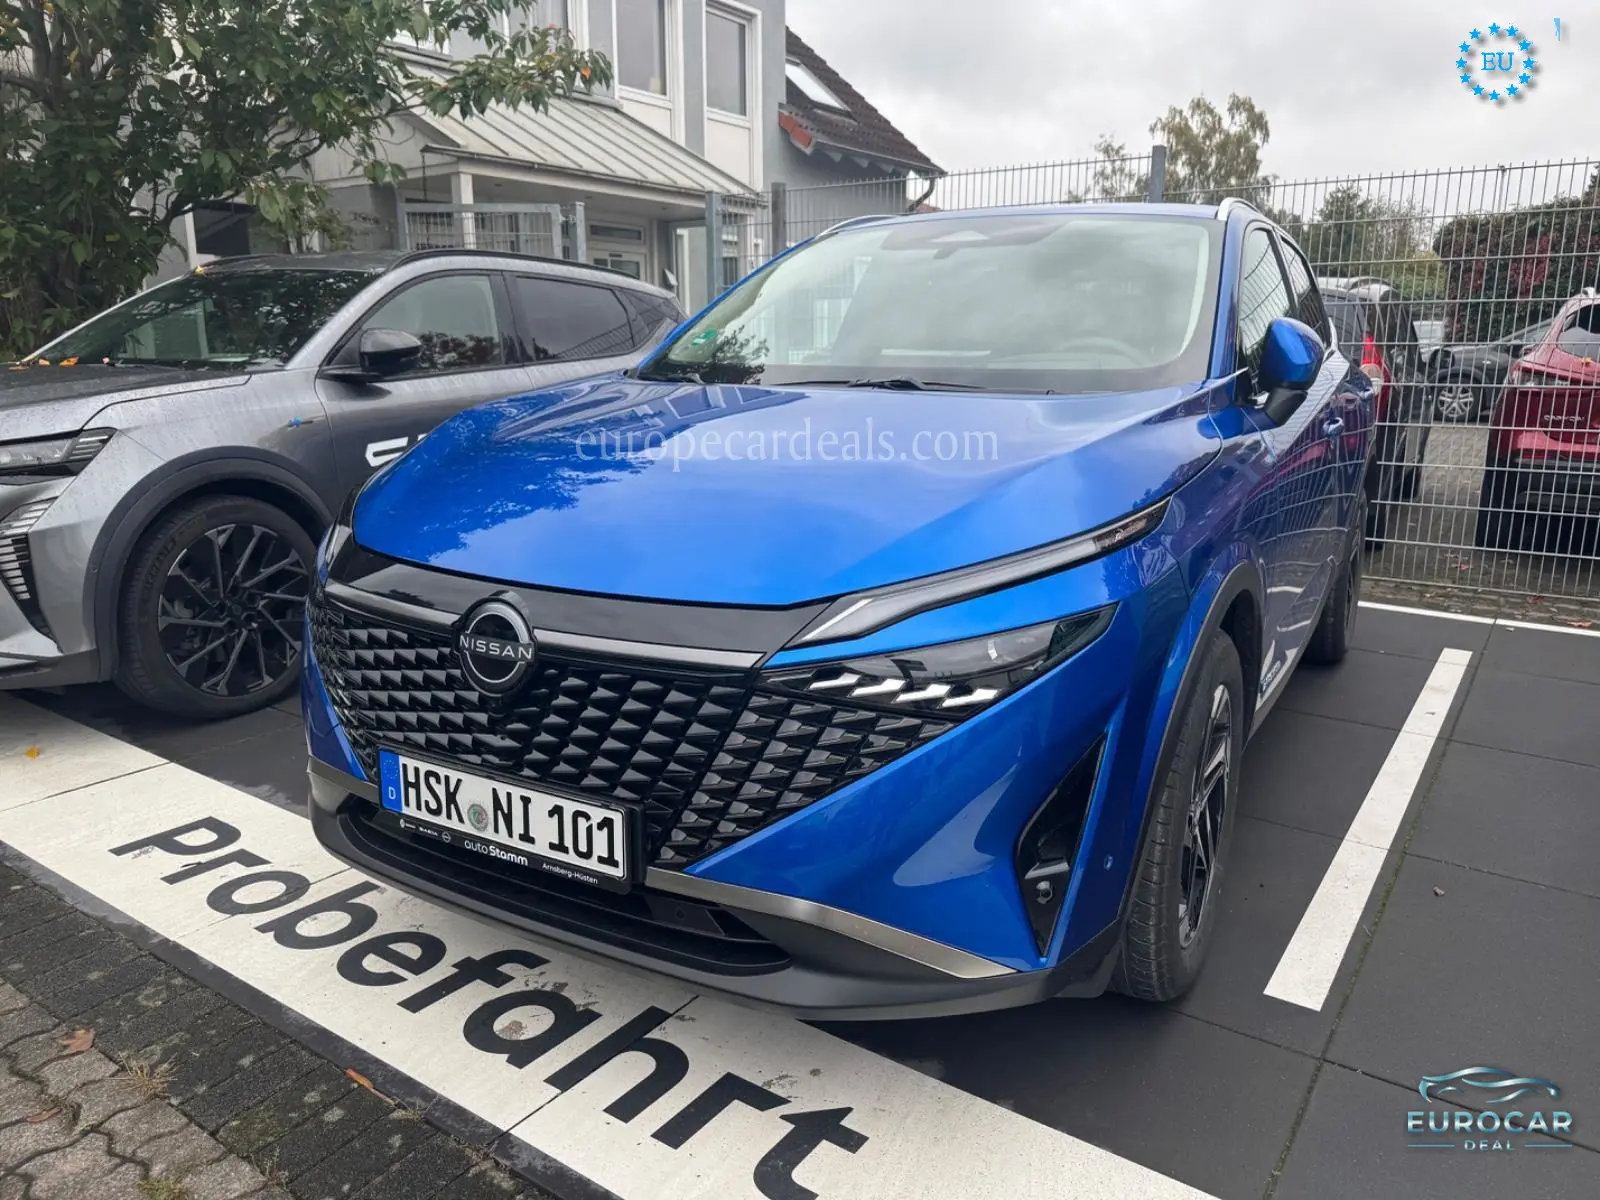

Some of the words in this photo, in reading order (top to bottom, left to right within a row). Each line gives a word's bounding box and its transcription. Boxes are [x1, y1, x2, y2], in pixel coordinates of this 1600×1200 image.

[460, 635, 532, 659] NISSAN
[388, 786, 396, 800] D
[401, 762, 465, 824] HSK
[491, 787, 536, 845] NI
[547, 804, 620, 869] 101
[107, 816, 870, 1200] Probefahrt
